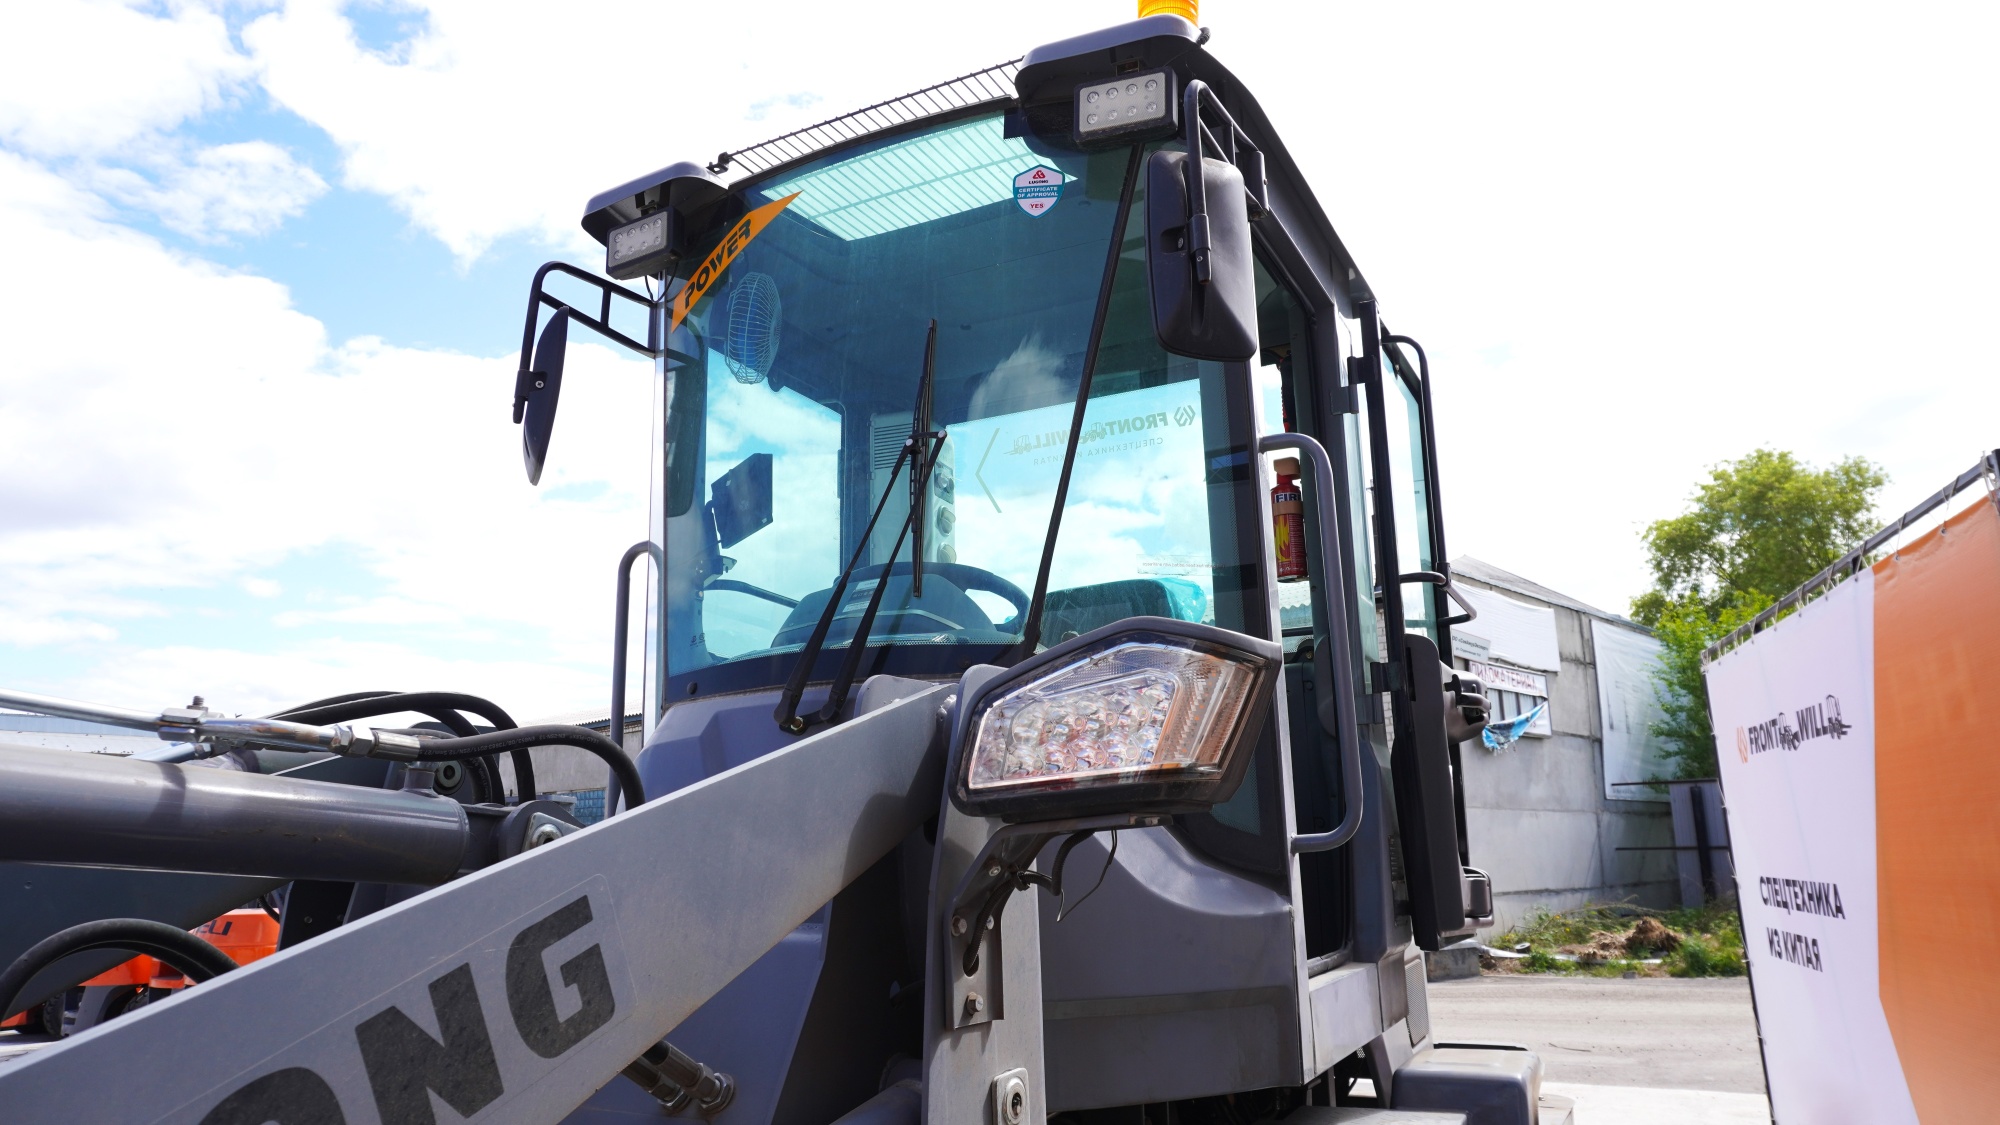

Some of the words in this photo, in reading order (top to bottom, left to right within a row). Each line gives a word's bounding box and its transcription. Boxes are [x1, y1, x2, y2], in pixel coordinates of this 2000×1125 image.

[684, 218, 752, 310] POWER
[1275, 493, 1302, 503] FIR
[1748, 718, 1780, 755] FRONT
[1796, 702, 1829, 742] WILL
[1759, 875, 1846, 920] СПЕЦТЕХНИКА
[1766, 926, 1782, 961] ИЗ
[1783, 932, 1823, 973] КИТАЯ
